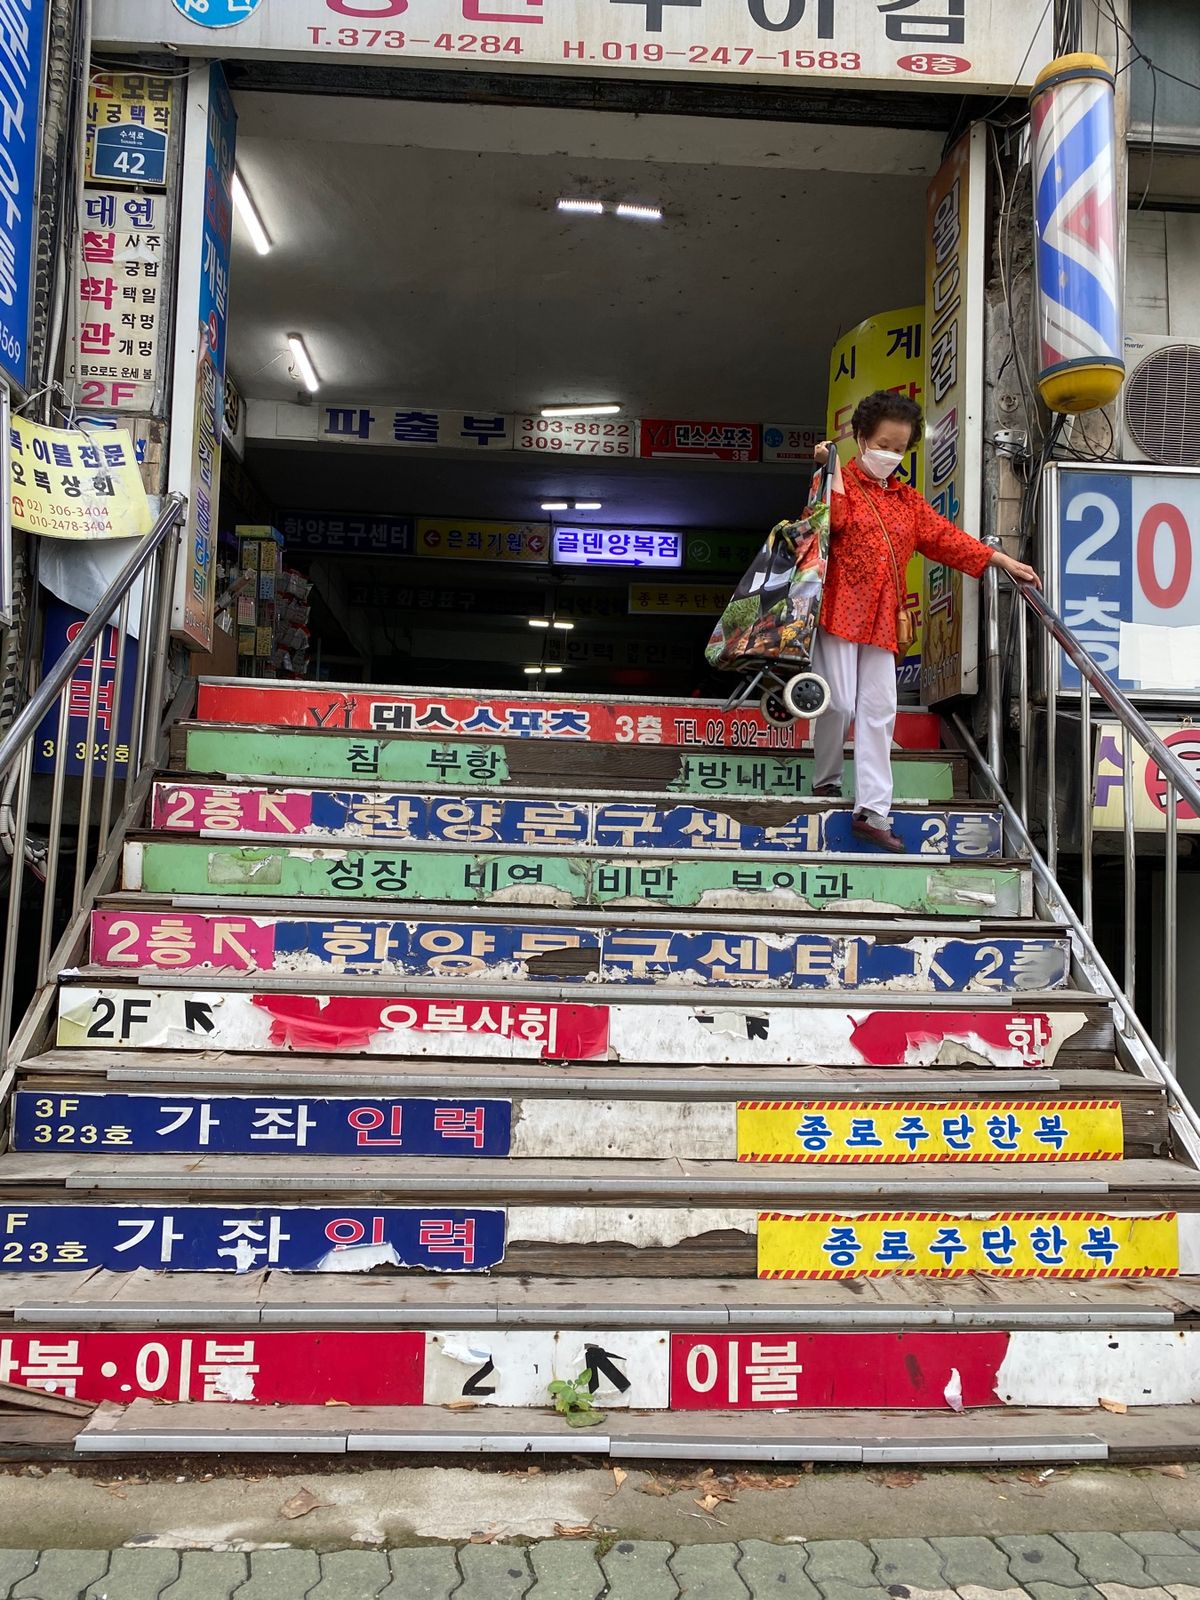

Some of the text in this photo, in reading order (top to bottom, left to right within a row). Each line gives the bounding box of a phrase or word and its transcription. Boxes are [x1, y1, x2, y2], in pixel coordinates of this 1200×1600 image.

[307, 26, 861, 71] T.373-4284 H.019-247-1583
[910, 56, 958, 73] 3층
[119, 130, 145, 140] 수색로
[113, 151, 146, 175] 42
[84, 194, 157, 229] 대연
[125, 234, 161, 251] 사주
[124, 261, 159, 277] 궁합
[122, 287, 157, 304] 택일
[121, 313, 155, 330] 작명
[118, 339, 153, 356] 개명
[80, 380, 137, 406] 2F
[324, 407, 507, 446] 파출부
[521, 418, 630, 438] 303-8822
[674, 424, 753, 449] 댄스스포츠
[521, 435, 630, 455] 309-7755
[787, 431, 827, 448] 장인
[284, 517, 408, 549] 한양문구센터
[557, 531, 679, 559] 골덴양복점
[615, 715, 662, 744] 3층
[346, 744, 379, 775] 침
[426, 748, 500, 780] 부항
[164, 792, 244, 831] 2층
[326, 858, 414, 891] 성장
[598, 867, 678, 900] 비만
[106, 918, 196, 965] 2층
[87, 997, 152, 1039] 2F
[34, 1099, 80, 1118] 3F
[33, 1123, 134, 1146] 323호
[686, 1341, 803, 1403] 이불
